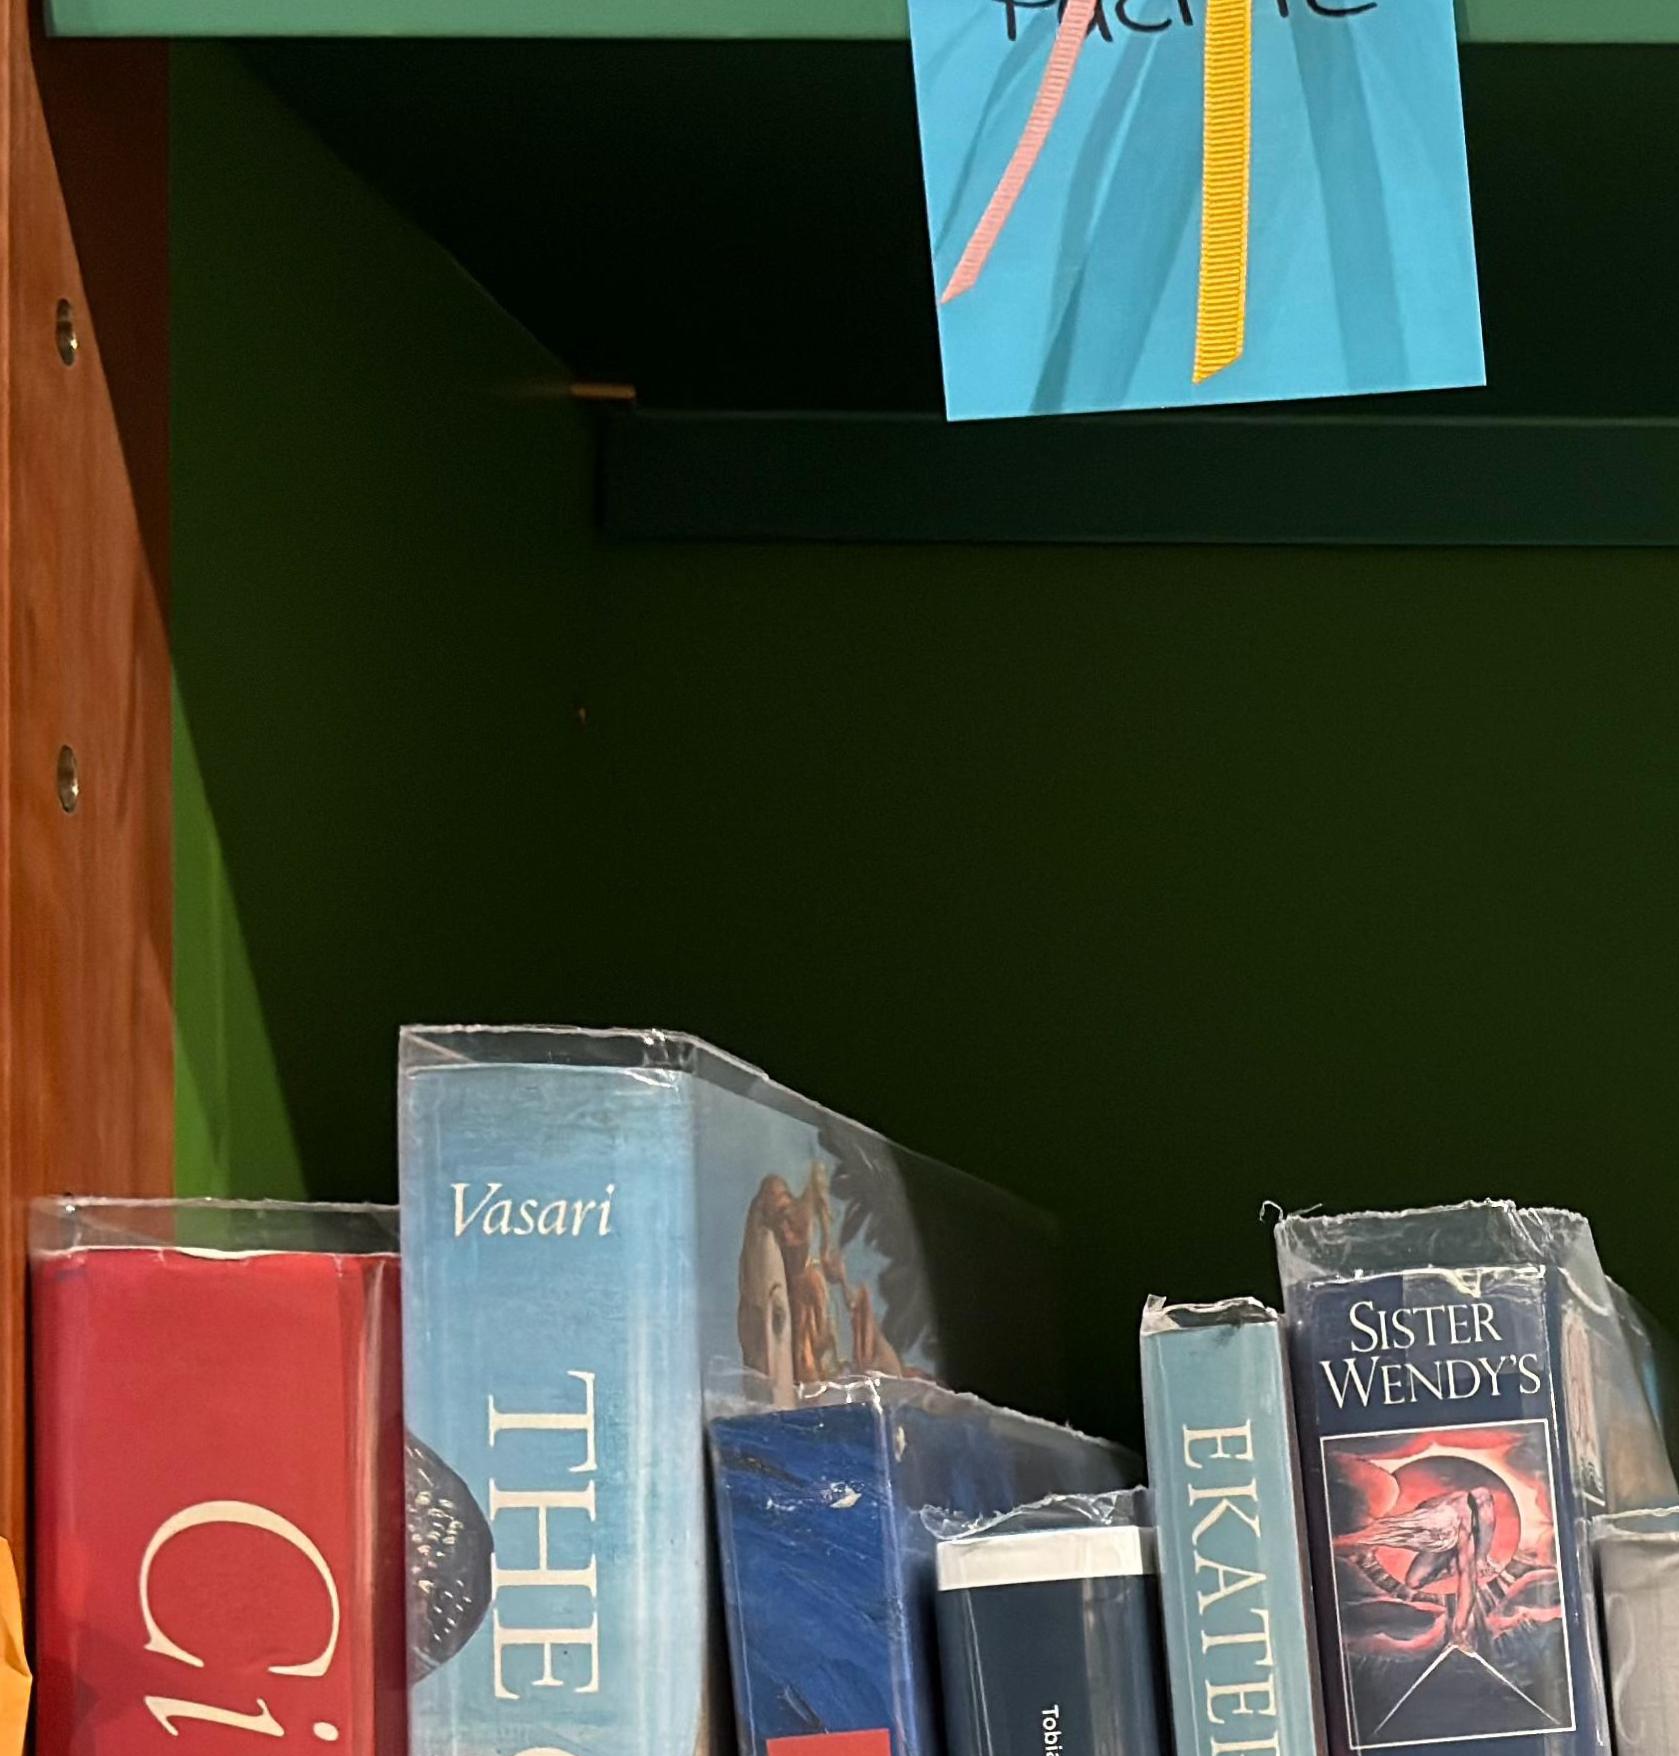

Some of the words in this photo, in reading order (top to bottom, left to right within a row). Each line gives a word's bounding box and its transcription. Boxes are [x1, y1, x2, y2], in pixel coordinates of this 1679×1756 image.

[450, 1182, 615, 1238] Vasari
[1349, 1300, 1503, 1353] SISTER
[1320, 1353, 1542, 1409] WENDY'S
[487, 1369, 600, 1700] THE
